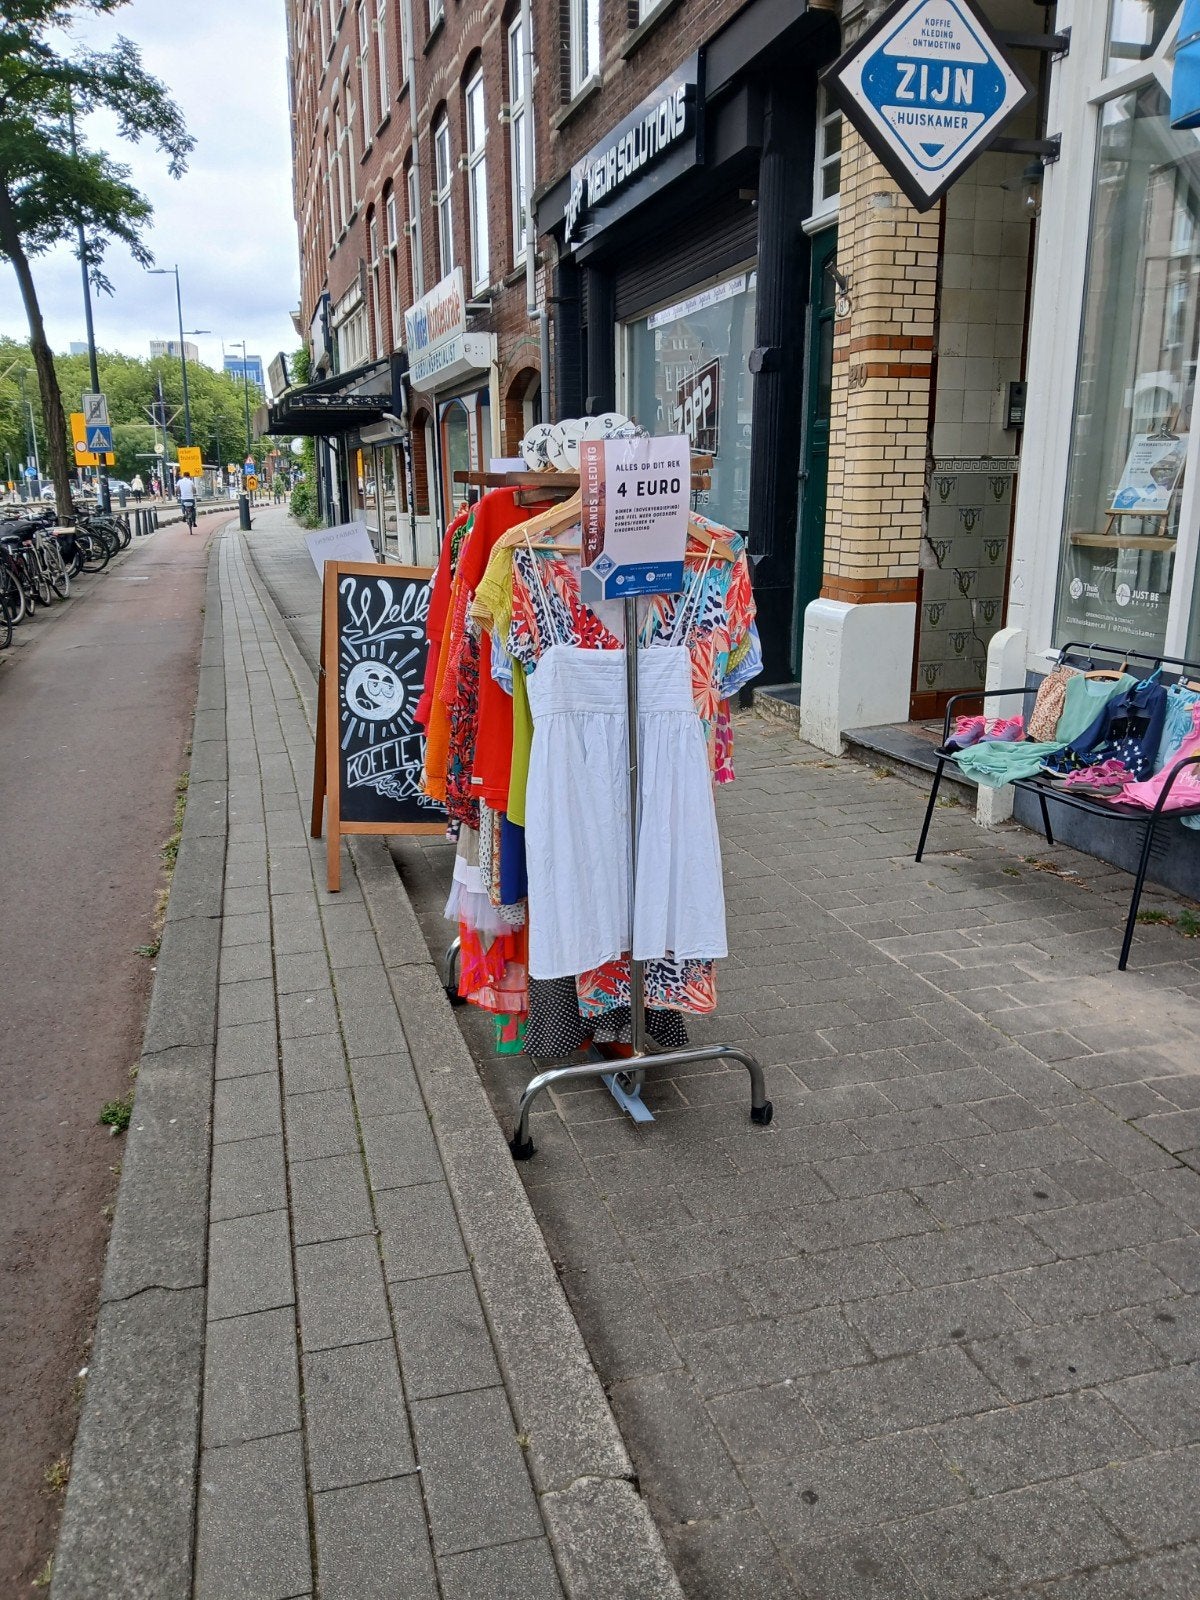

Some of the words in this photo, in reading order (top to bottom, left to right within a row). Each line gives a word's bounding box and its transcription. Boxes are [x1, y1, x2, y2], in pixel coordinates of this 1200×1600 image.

[925, 18, 951, 28] KOFFIE
[921, 28, 954, 39] KLEDING
[913, 36, 961, 50] ONTMOETING
[895, 62, 974, 104] ZIJN
[897, 112, 968, 129] HUISKAMER
[849, 363, 868, 389] 20
[604, 418, 613, 429] S
[526, 440, 536, 453] XL
[567, 439, 577, 449] M
[587, 446, 598, 495] KLEDING
[615, 463, 638, 472] ALLES
[641, 462, 651, 471] OP
[653, 461, 665, 469] DIT
[667, 460, 681, 468] REK
[617, 481, 628, 498] 4
[636, 478, 681, 497] EURO
[588, 499, 599, 534] HANDS
[588, 538, 597, 551] 2E
[1083, 582, 1098, 592] Thuis
[1132, 590, 1149, 600] JUST
[1150, 592, 1159, 601] BE
[339, 576, 430, 636] Welk
